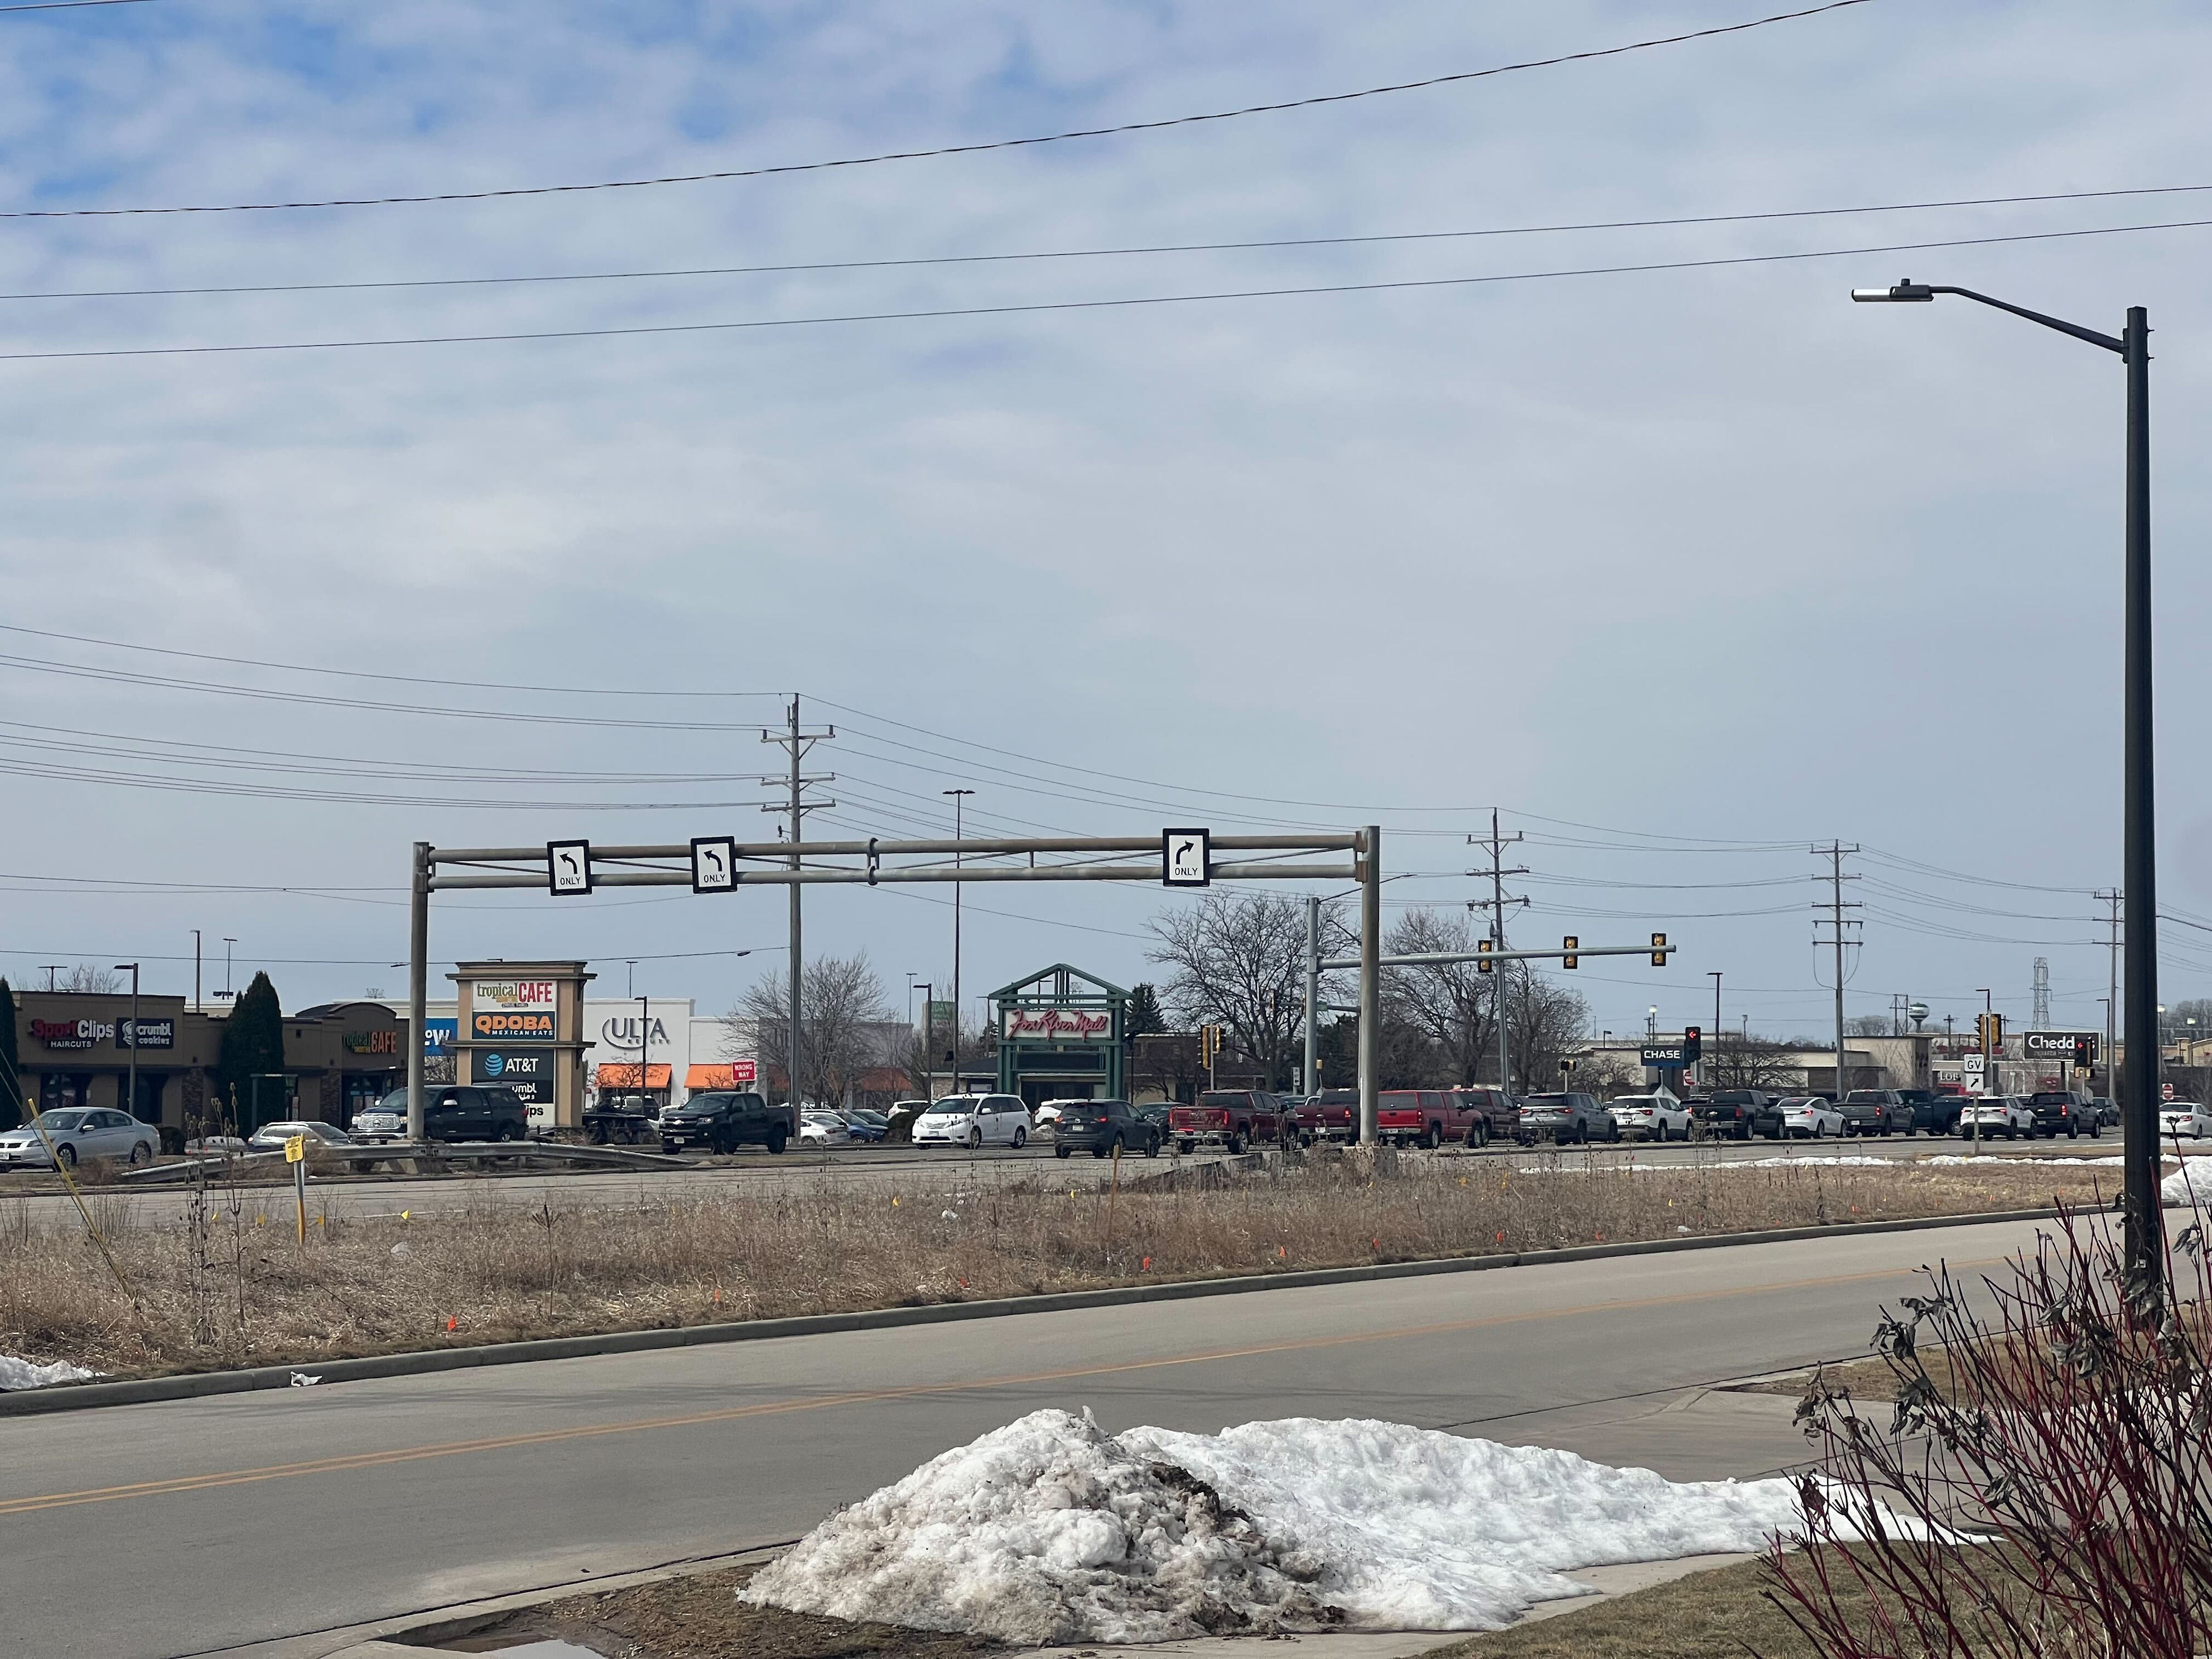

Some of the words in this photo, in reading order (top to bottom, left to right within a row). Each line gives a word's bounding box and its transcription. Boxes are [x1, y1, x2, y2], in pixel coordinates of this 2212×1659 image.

[1175, 867, 1198, 876] ONLY
[560, 876, 581, 885] ONLY
[703, 874, 725, 883] ONLY
[477, 982, 518, 999] tropical
[519, 982, 553, 1002] CAFE
[77, 1020, 114, 1041] Clips
[136, 1023, 172, 1036] crumbl
[475, 1015, 552, 1034] QDOBA
[1006, 1010, 1038, 1040] Fox
[1036, 1009, 1073, 1041] River
[1071, 1010, 1109, 1041] Mall
[370, 1031, 397, 1054] CAFE
[1644, 1050, 1680, 1059] CHASE
[505, 1058, 539, 1072] AT&T
[1967, 1060, 1981, 1069] GV
